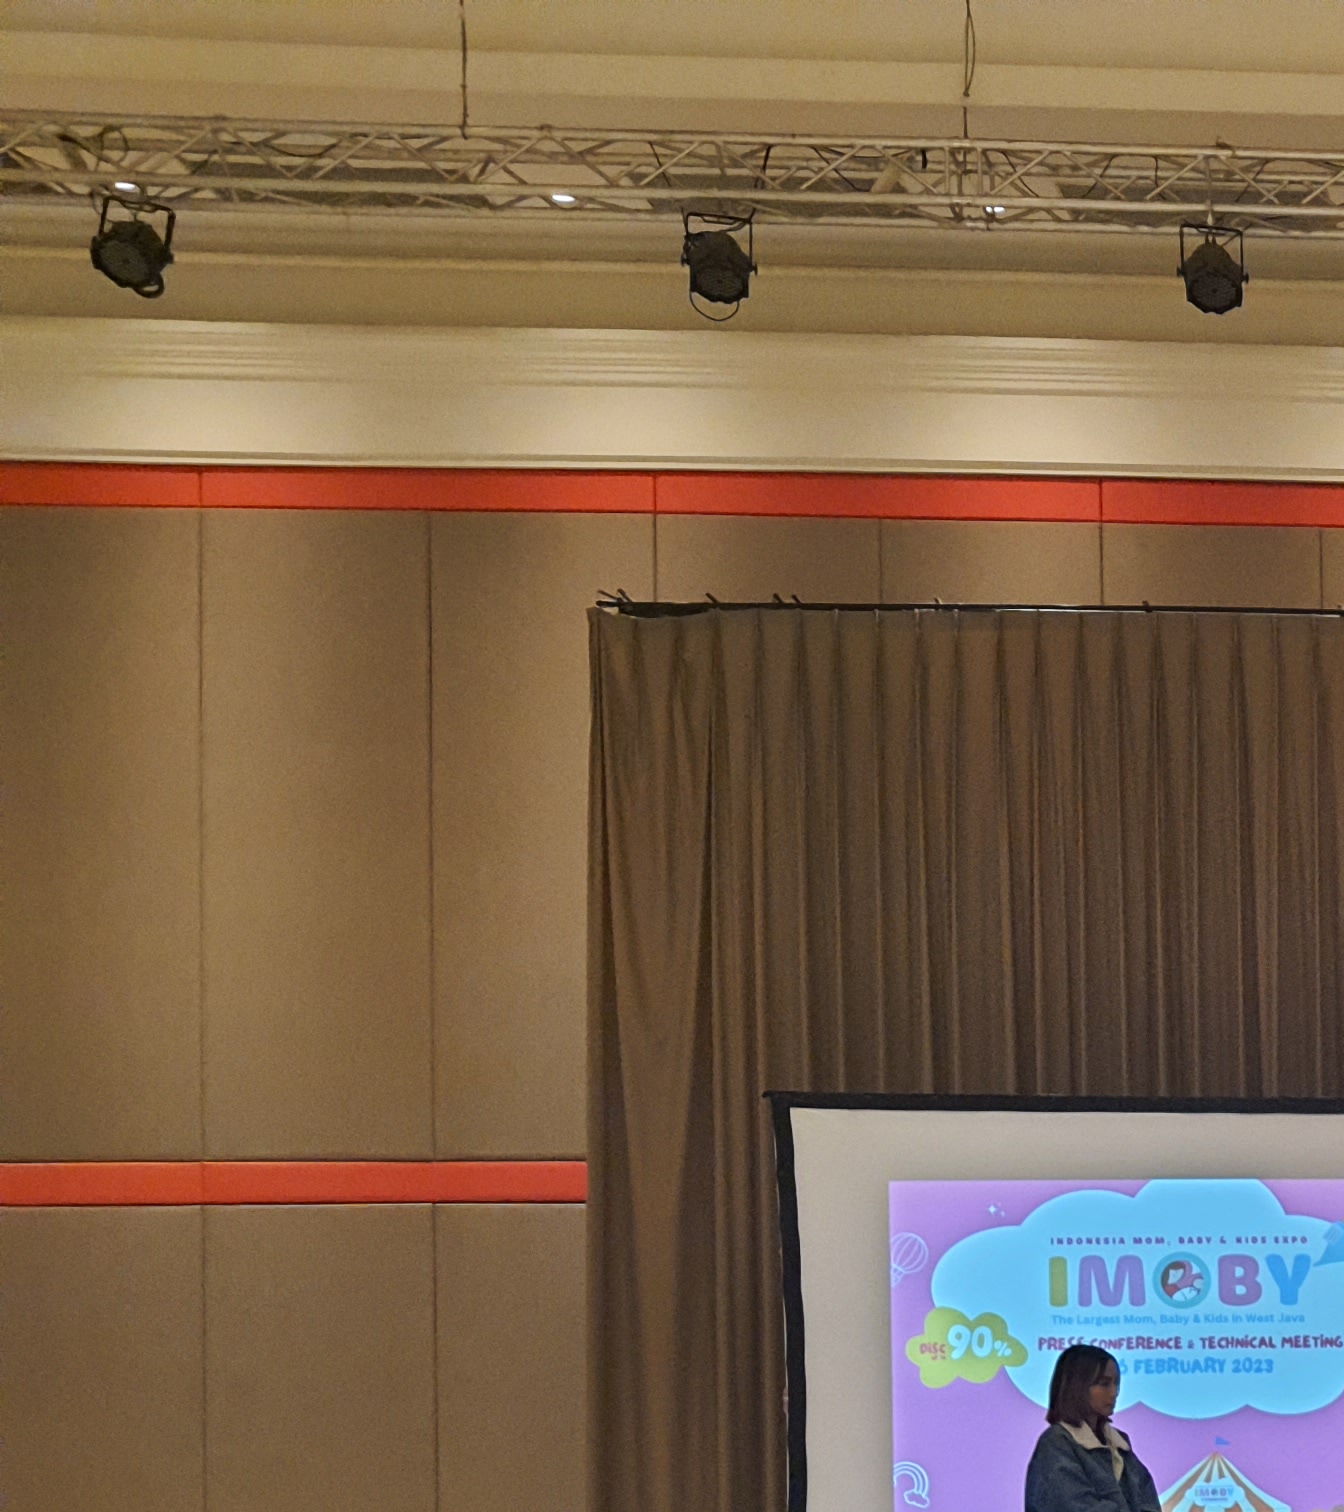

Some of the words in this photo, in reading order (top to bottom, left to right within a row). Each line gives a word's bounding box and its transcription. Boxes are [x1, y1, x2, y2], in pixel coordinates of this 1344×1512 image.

[1050, 1236, 1126, 1246] INDONESIA
[1235, 1236, 1267, 1246] KIDS
[1274, 1236, 1308, 1245] EXPO
[1048, 1251, 1311, 1309] IMOBY
[1051, 1314, 1073, 1325] The
[1076, 1314, 1120, 1327] Largest
[1160, 1313, 1190, 1326] Baby
[1203, 1313, 1229, 1323] Kids
[1245, 1313, 1275, 1323] West
[1277, 1313, 1305, 1323] Java
[948, 1324, 1012, 1359] 90%
[1133, 1357, 1225, 1374] FEBRUARY
[1231, 1358, 1274, 1374] 2023
